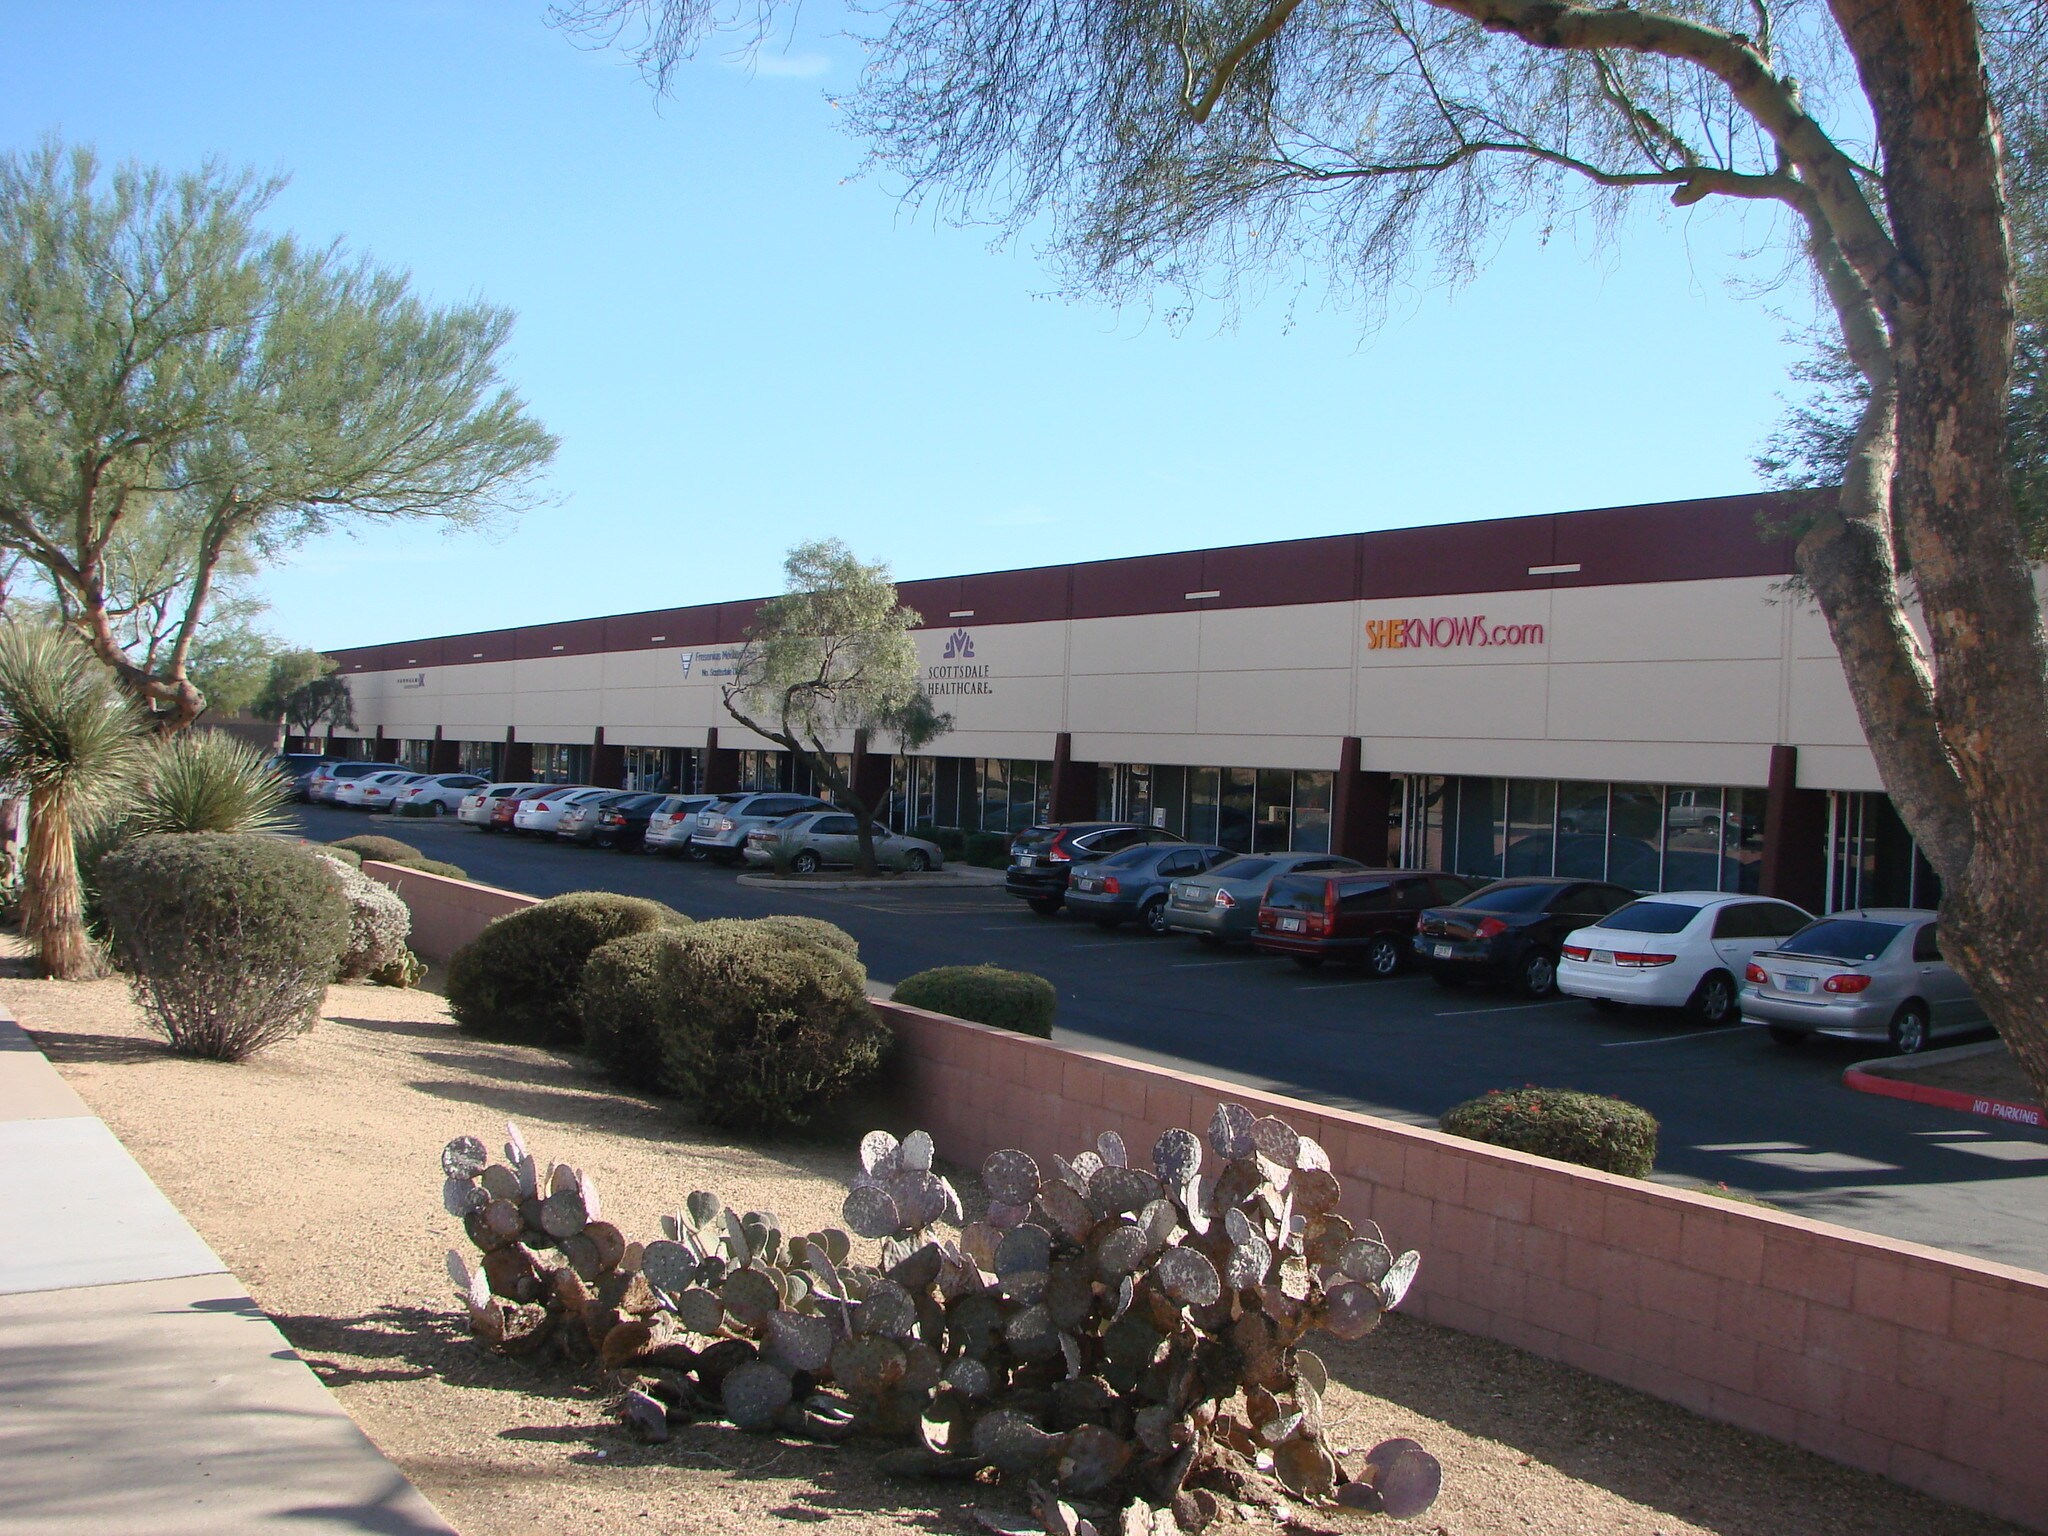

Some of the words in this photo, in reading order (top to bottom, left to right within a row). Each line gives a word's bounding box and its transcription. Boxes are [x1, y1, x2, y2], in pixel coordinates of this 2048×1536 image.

[1365, 615, 1543, 649] SHEKNOWS.com
[928, 665, 989, 679] SCOTTSDALE
[1973, 1100, 1989, 1113] NO
[1992, 1104, 2039, 1125] PARKING
